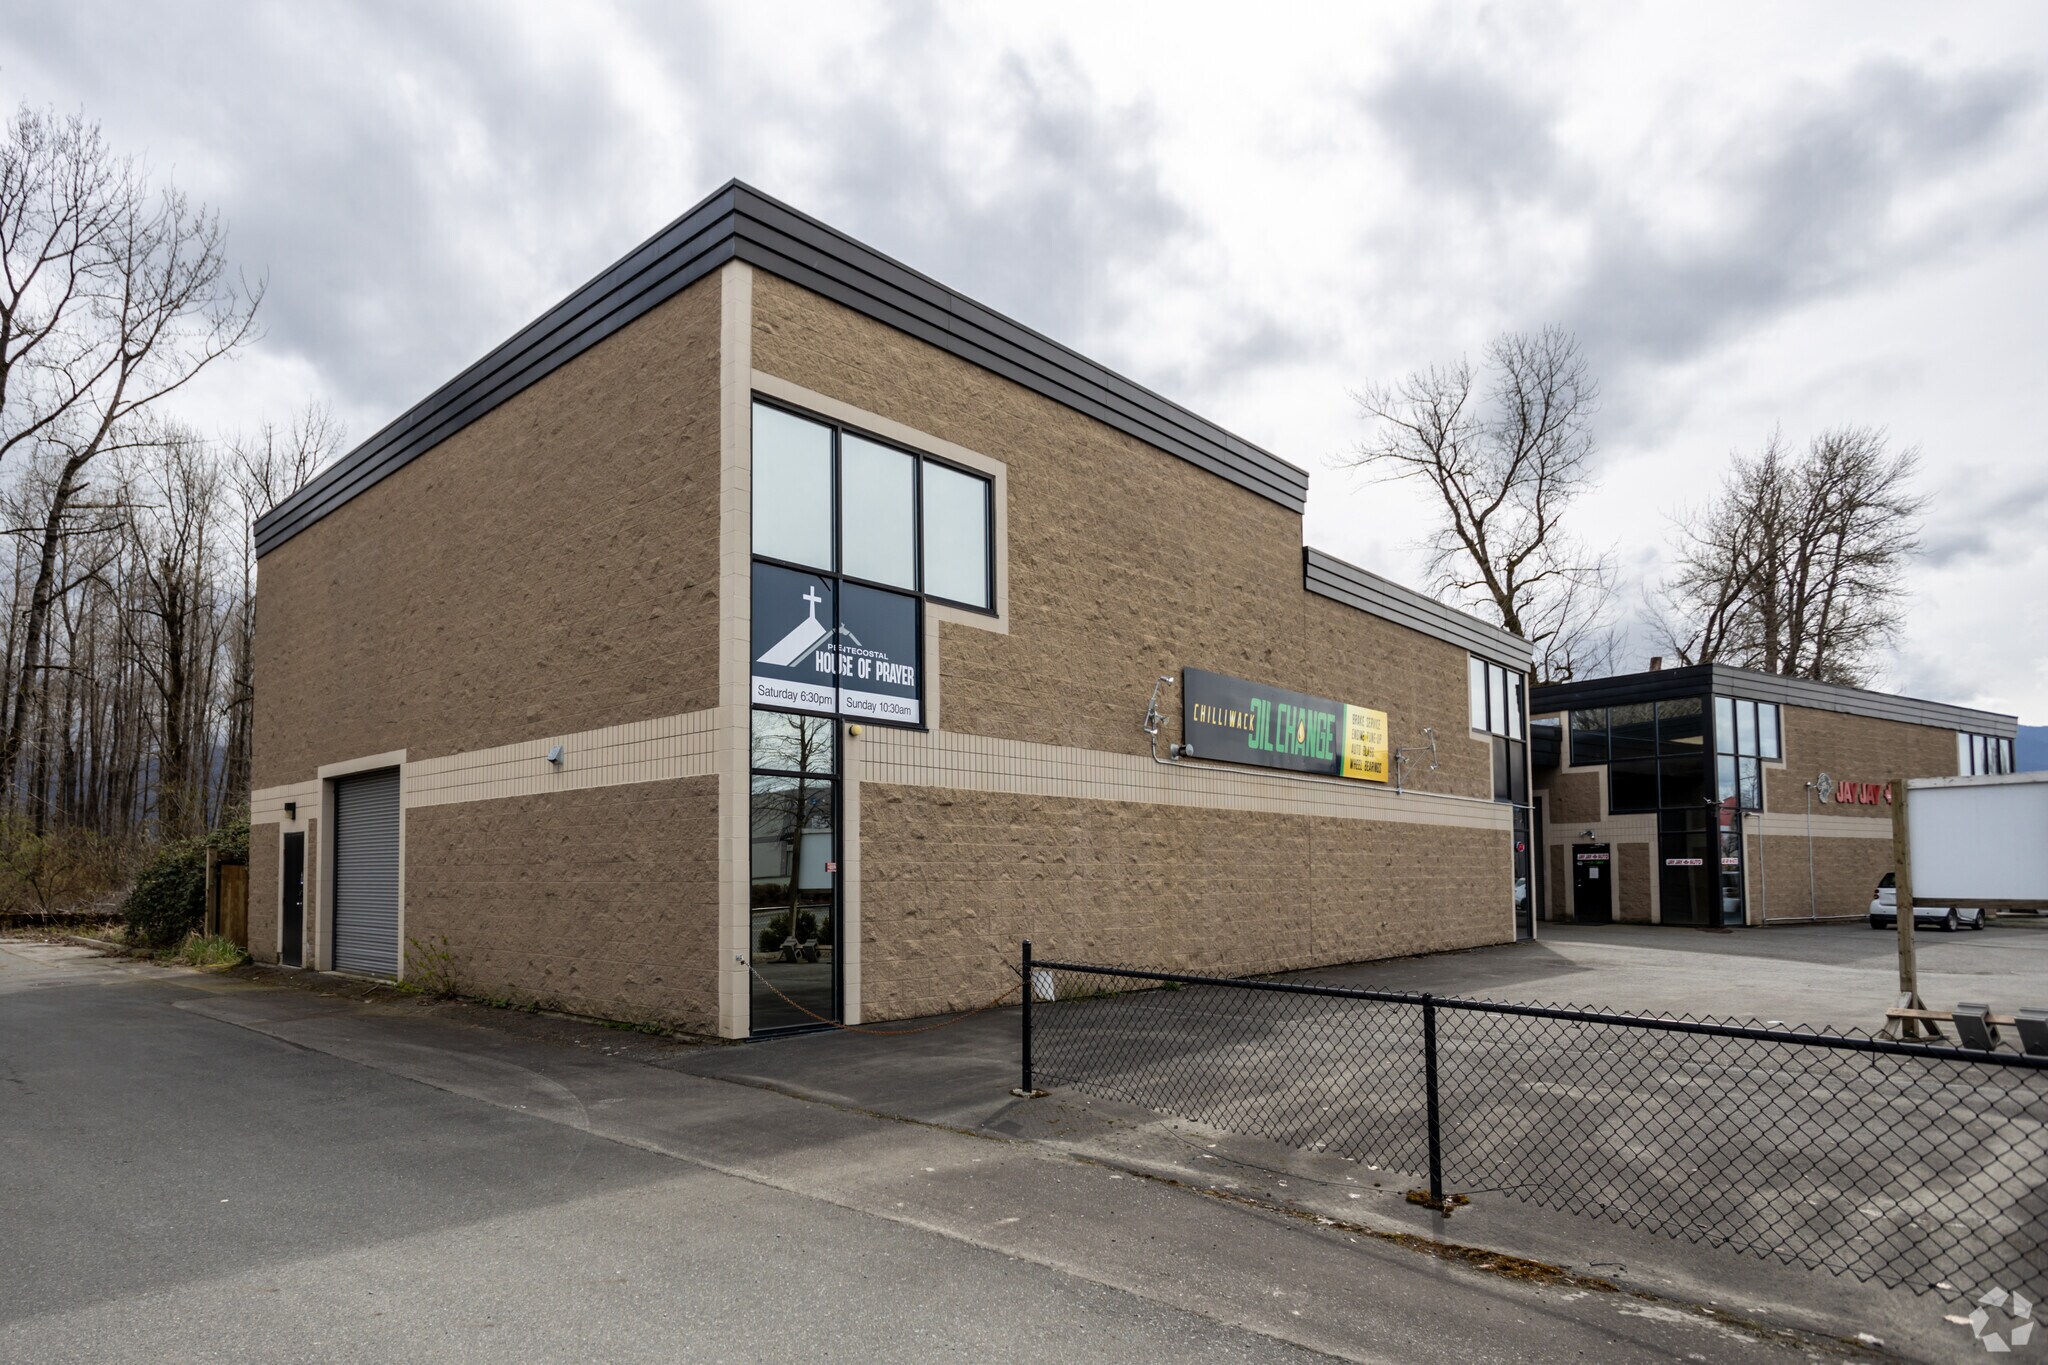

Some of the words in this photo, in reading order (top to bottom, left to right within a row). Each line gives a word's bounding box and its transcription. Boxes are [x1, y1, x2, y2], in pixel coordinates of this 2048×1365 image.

[857, 657, 872, 679] OF
[875, 660, 915, 686] PRAYER
[757, 684, 798, 703] Saturday
[800, 690, 833, 706] 6:30pm
[846, 696, 877, 714] Sunday
[879, 702, 912, 716] 10:30am
[1193, 703, 1255, 731] CHILLIWACK
[1248, 697, 1274, 752] OIL
[1275, 703, 1336, 761] CHANGE
[1836, 781, 1858, 804] JAY
[1859, 783, 1881, 805] JAY
